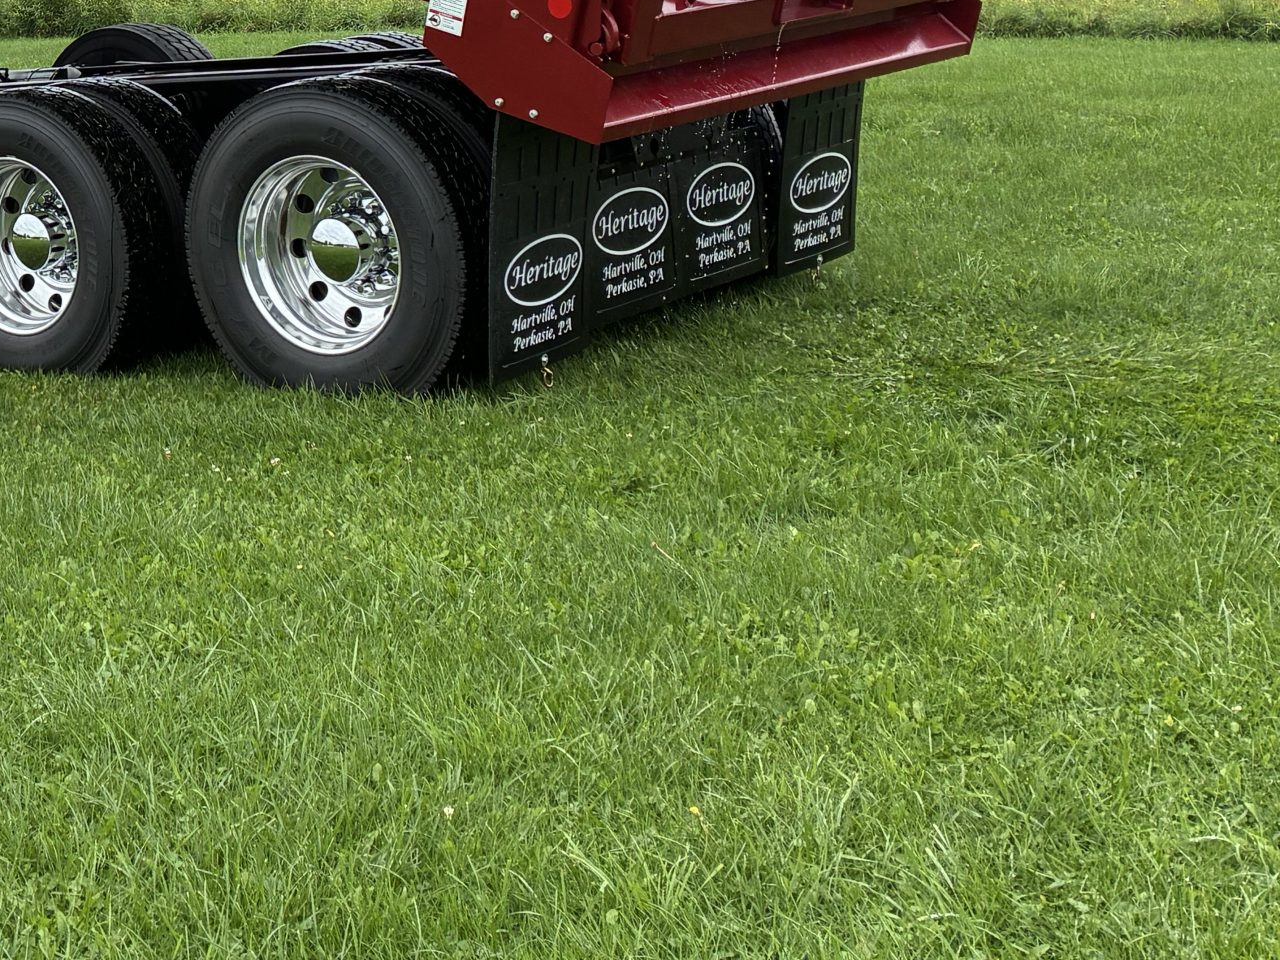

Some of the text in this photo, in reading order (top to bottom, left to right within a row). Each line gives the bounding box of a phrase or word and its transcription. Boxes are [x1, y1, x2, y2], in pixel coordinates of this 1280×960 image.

[691, 179, 751, 211] Heritage
[793, 168, 848, 199] Heritage
[598, 204, 665, 240] Heritage
[695, 218, 752, 251] Hartville, OH
[792, 205, 845, 237] Hartville, OH
[699, 239, 751, 268] Perkasie, PA
[794, 224, 842, 252] Perkasie, PA
[510, 251, 579, 290] Heritage
[602, 246, 666, 282] Hartville, OH
[605, 267, 665, 299] Perkasie, PA
[510, 295, 576, 334] Hartville, OH
[513, 317, 573, 352] Perkasie, PA
